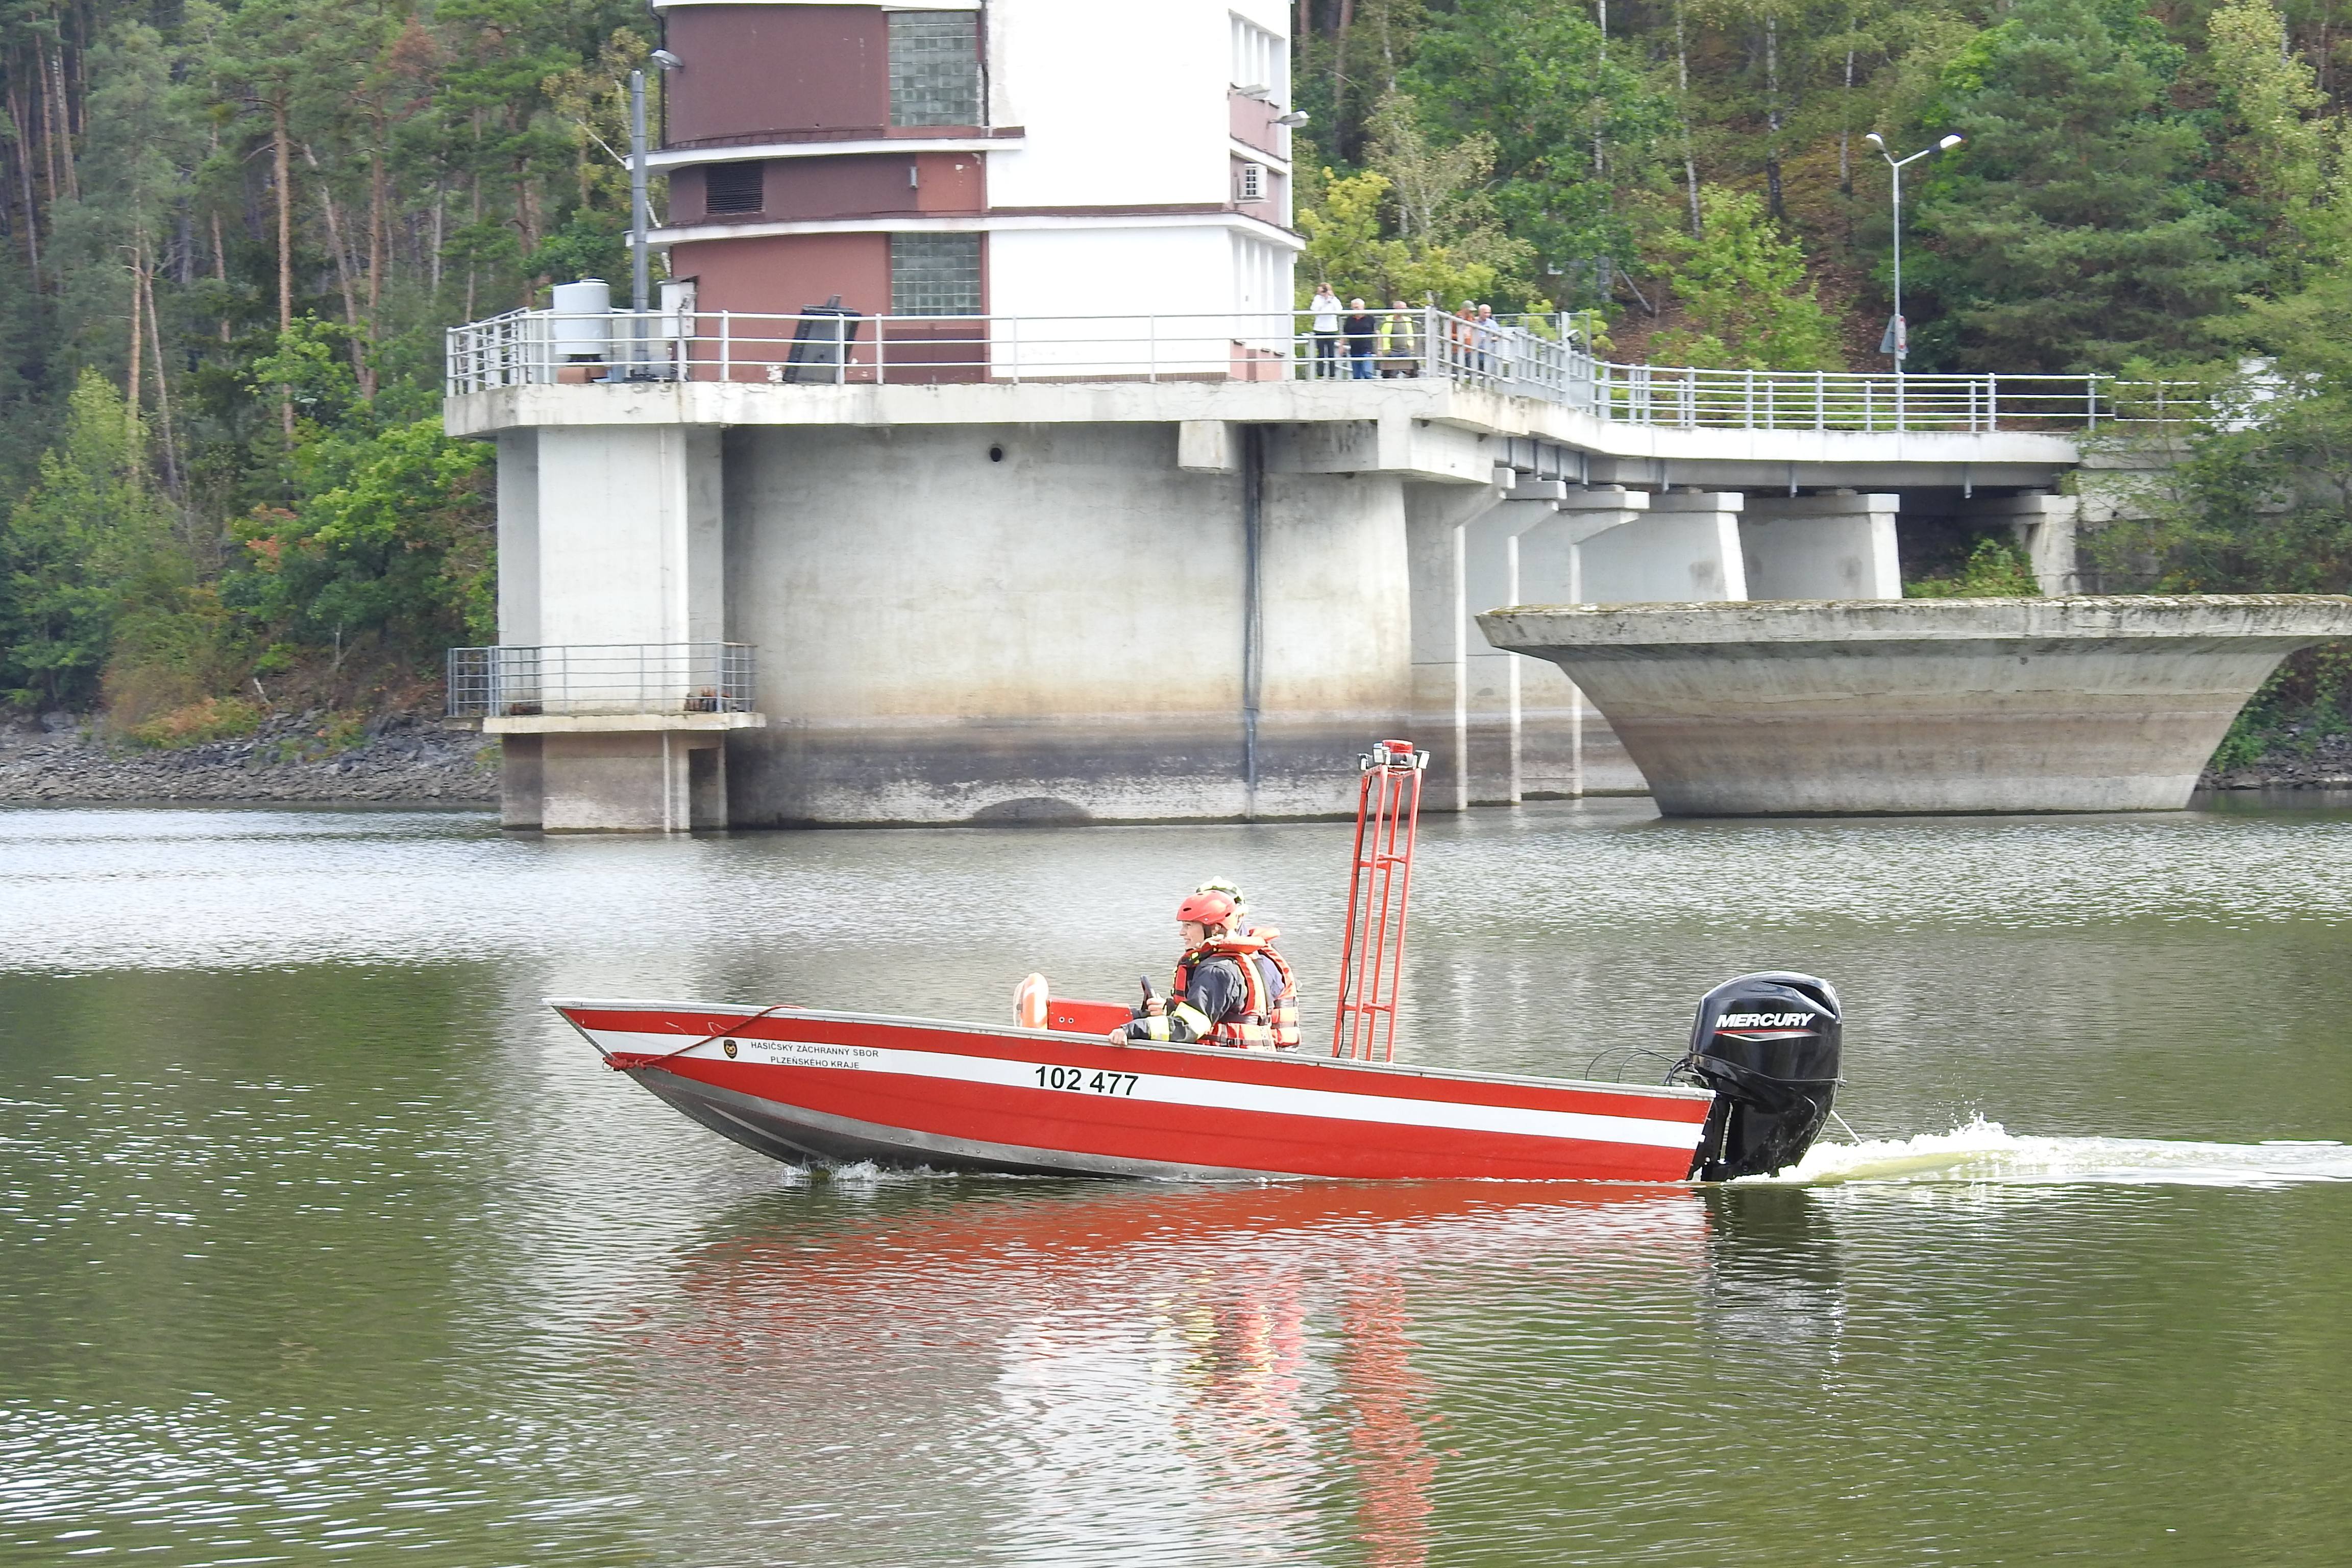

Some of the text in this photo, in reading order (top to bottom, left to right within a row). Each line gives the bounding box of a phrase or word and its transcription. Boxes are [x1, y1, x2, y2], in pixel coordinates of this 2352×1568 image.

[1716, 1013, 1816, 1027] MERCURY
[751, 1042, 878, 1057] HASIČSKÝ ZÁCHRANNÝ SBOR
[771, 1056, 860, 1069] PLZEŇSKÉHO KRAJE
[1036, 1066, 1139, 1095] 102 477
